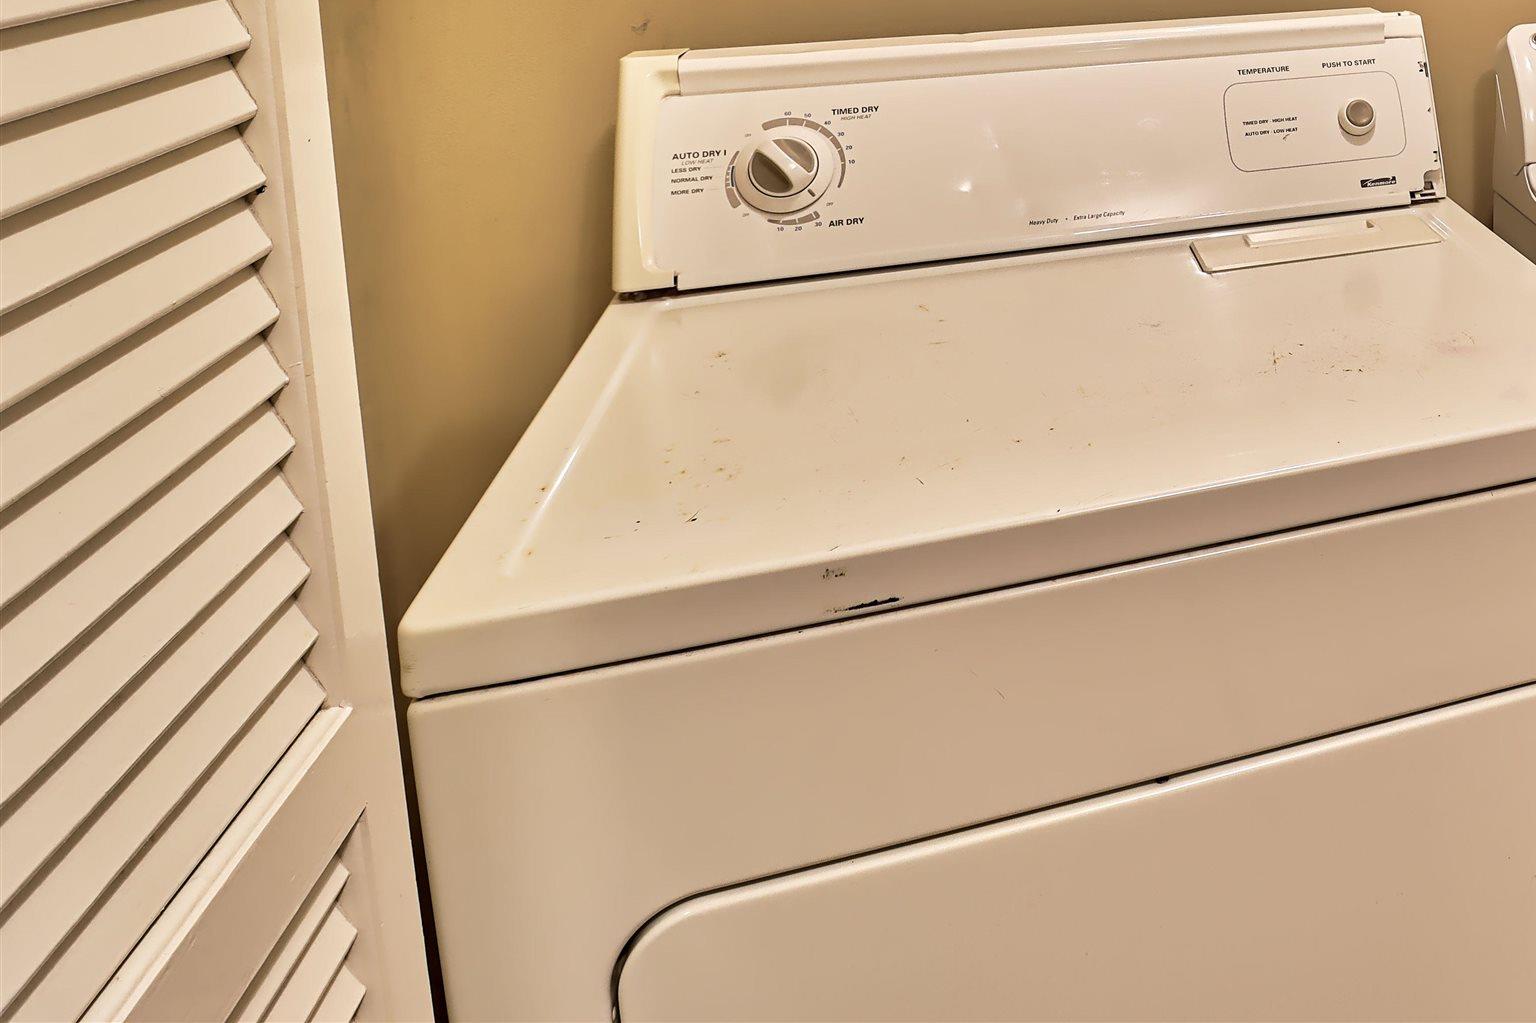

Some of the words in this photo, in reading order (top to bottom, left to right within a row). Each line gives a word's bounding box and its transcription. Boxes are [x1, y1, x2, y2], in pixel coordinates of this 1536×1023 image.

[1321, 61, 1342, 69] PUSH
[1354, 58, 1376, 66] START
[1237, 65, 1290, 76] TEMPERATURE
[831, 107, 859, 116] TIMED
[861, 105, 880, 114] DRY
[672, 151, 700, 160] AUTO
[702, 150, 722, 158] DRY
[1366, 179, 1396, 187] Kenmore
[828, 219, 844, 228] AIR
[846, 217, 865, 226] DRY
[1028, 218, 1046, 226] Heavy
[1046, 216, 1059, 224] Duty
[1102, 210, 1126, 218] Capacity
